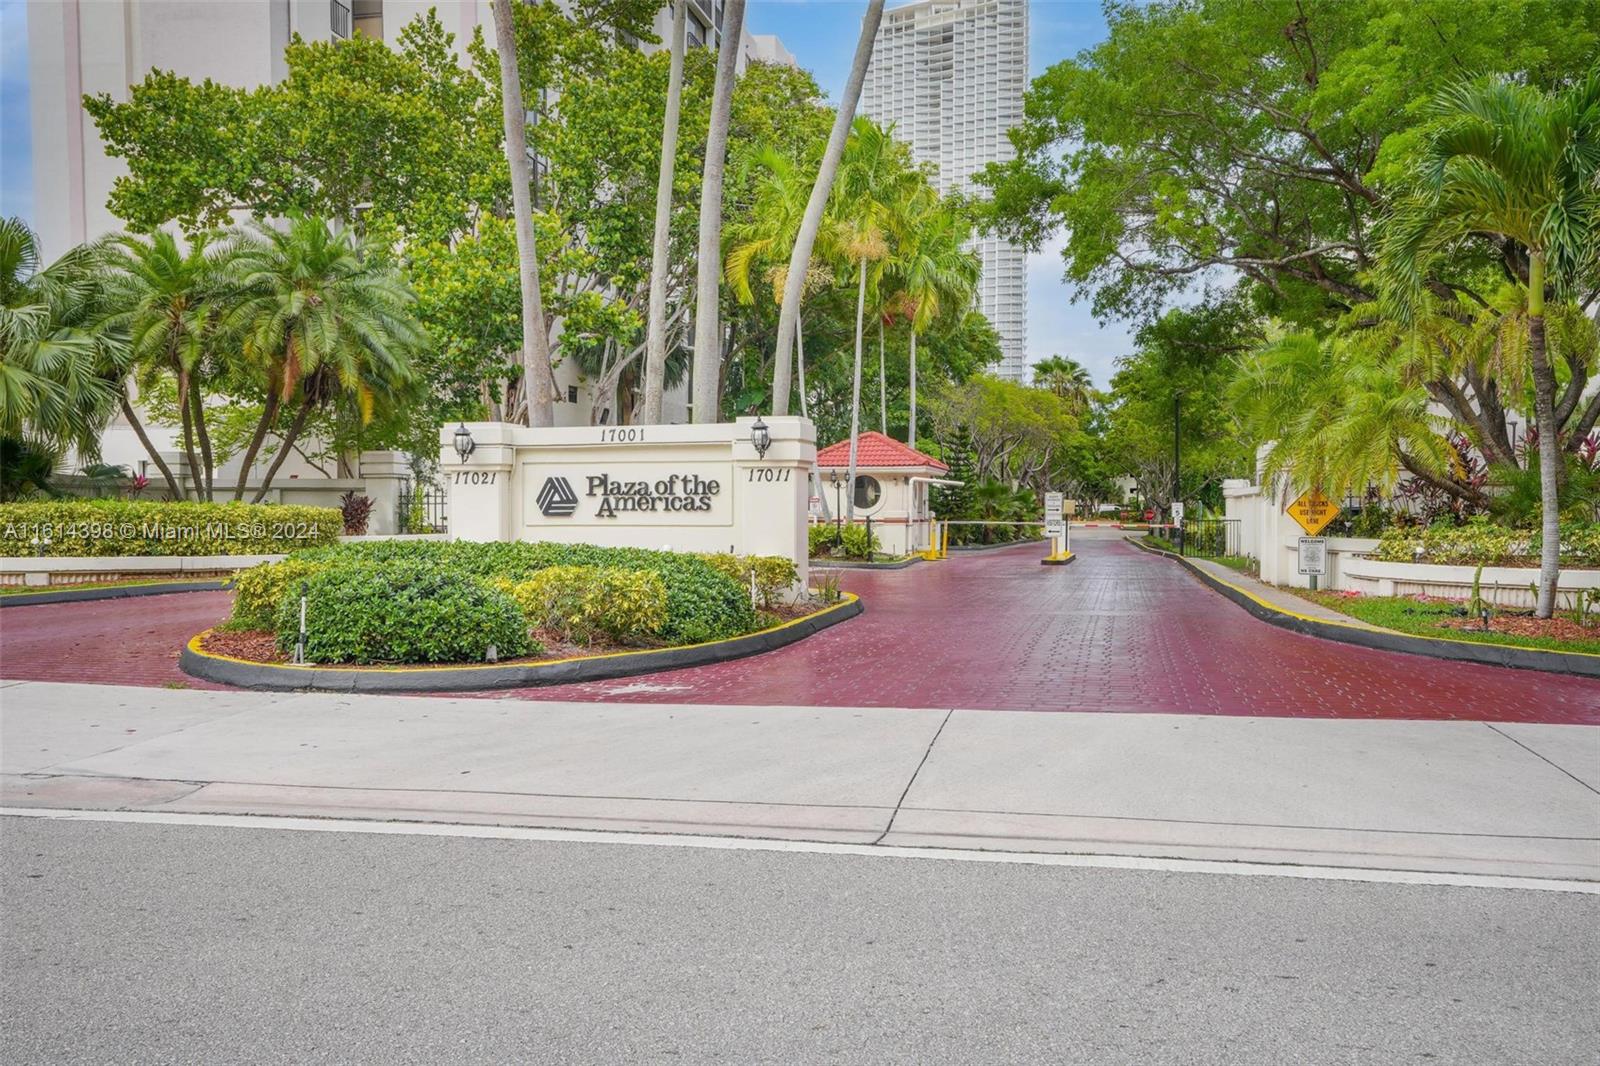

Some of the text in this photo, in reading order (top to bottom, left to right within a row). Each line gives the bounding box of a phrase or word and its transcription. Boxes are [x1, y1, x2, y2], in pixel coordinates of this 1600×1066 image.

[600, 428, 646, 442] 17001
[454, 471, 497, 485] 17021
[748, 468, 791, 483] 17011
[586, 473, 720, 497] Plaza of the
[595, 496, 712, 518] Americas
